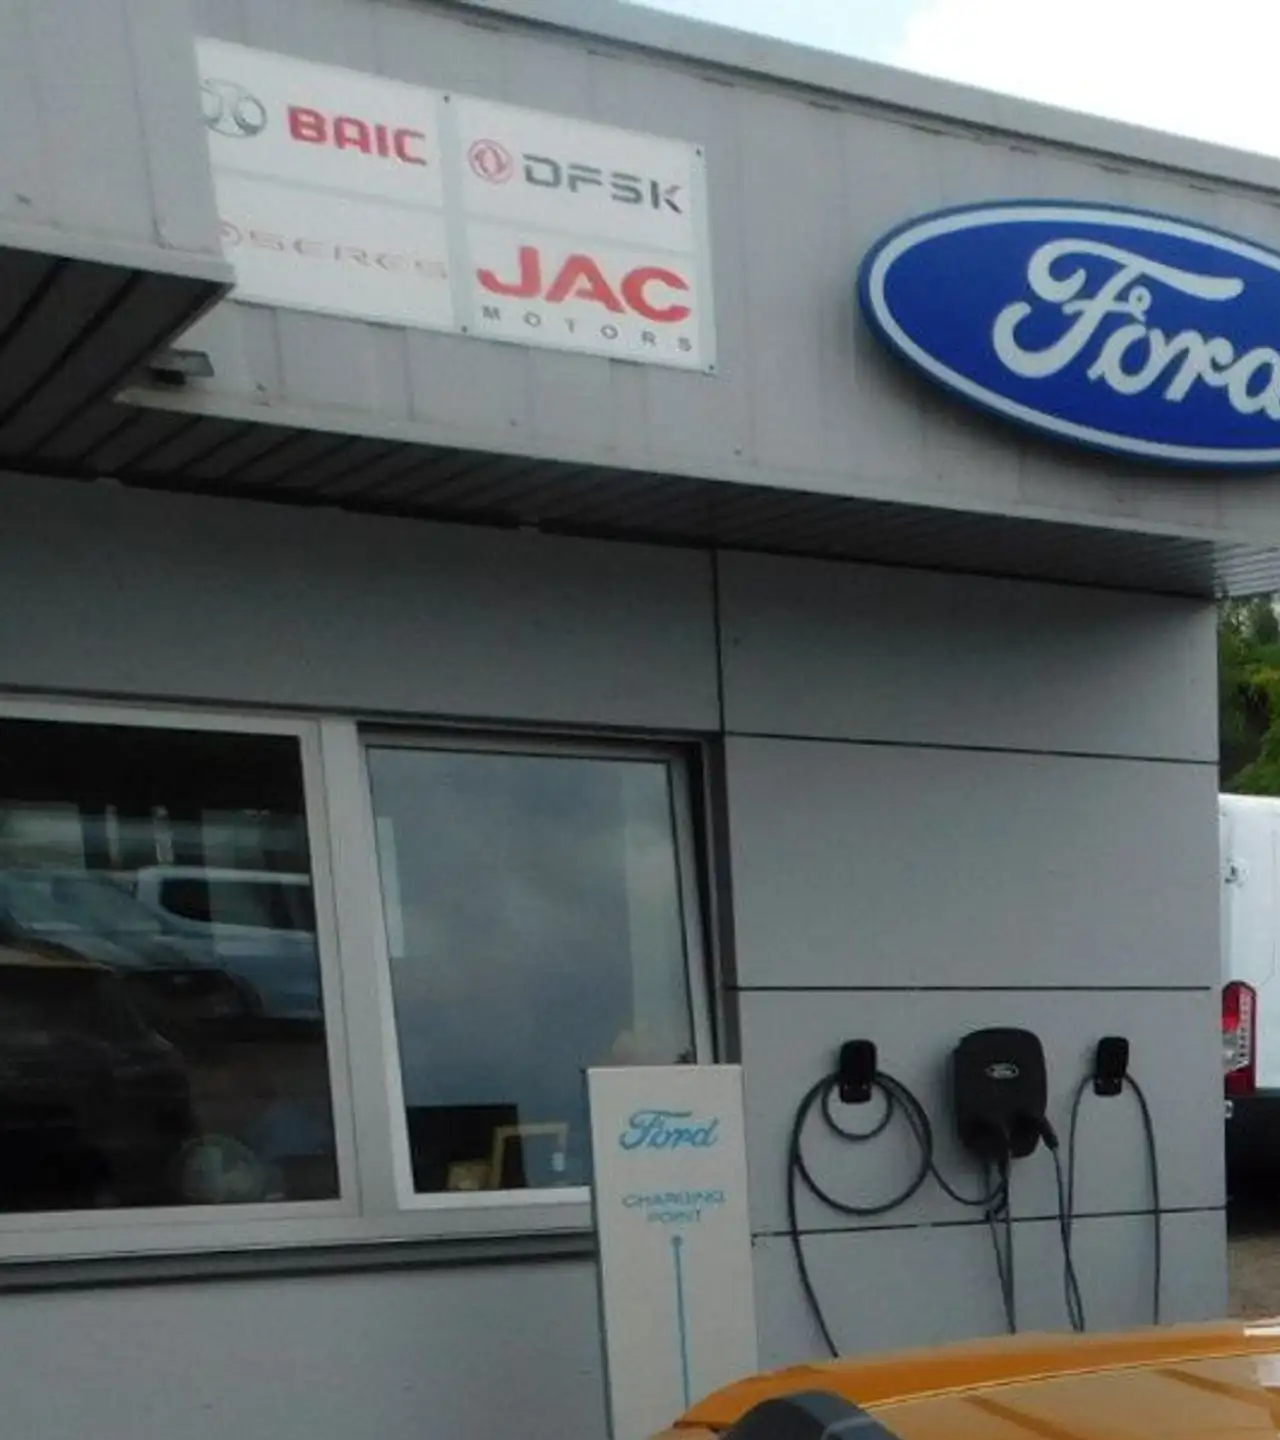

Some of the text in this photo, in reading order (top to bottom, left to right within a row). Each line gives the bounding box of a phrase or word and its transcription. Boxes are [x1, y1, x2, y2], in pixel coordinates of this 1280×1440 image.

[287, 106, 427, 166] BAIC
[523, 153, 683, 214] DFSK
[476, 246, 691, 324] JAC
[482, 305, 692, 351] MOTORS
[619, 1109, 719, 1150] Ford
